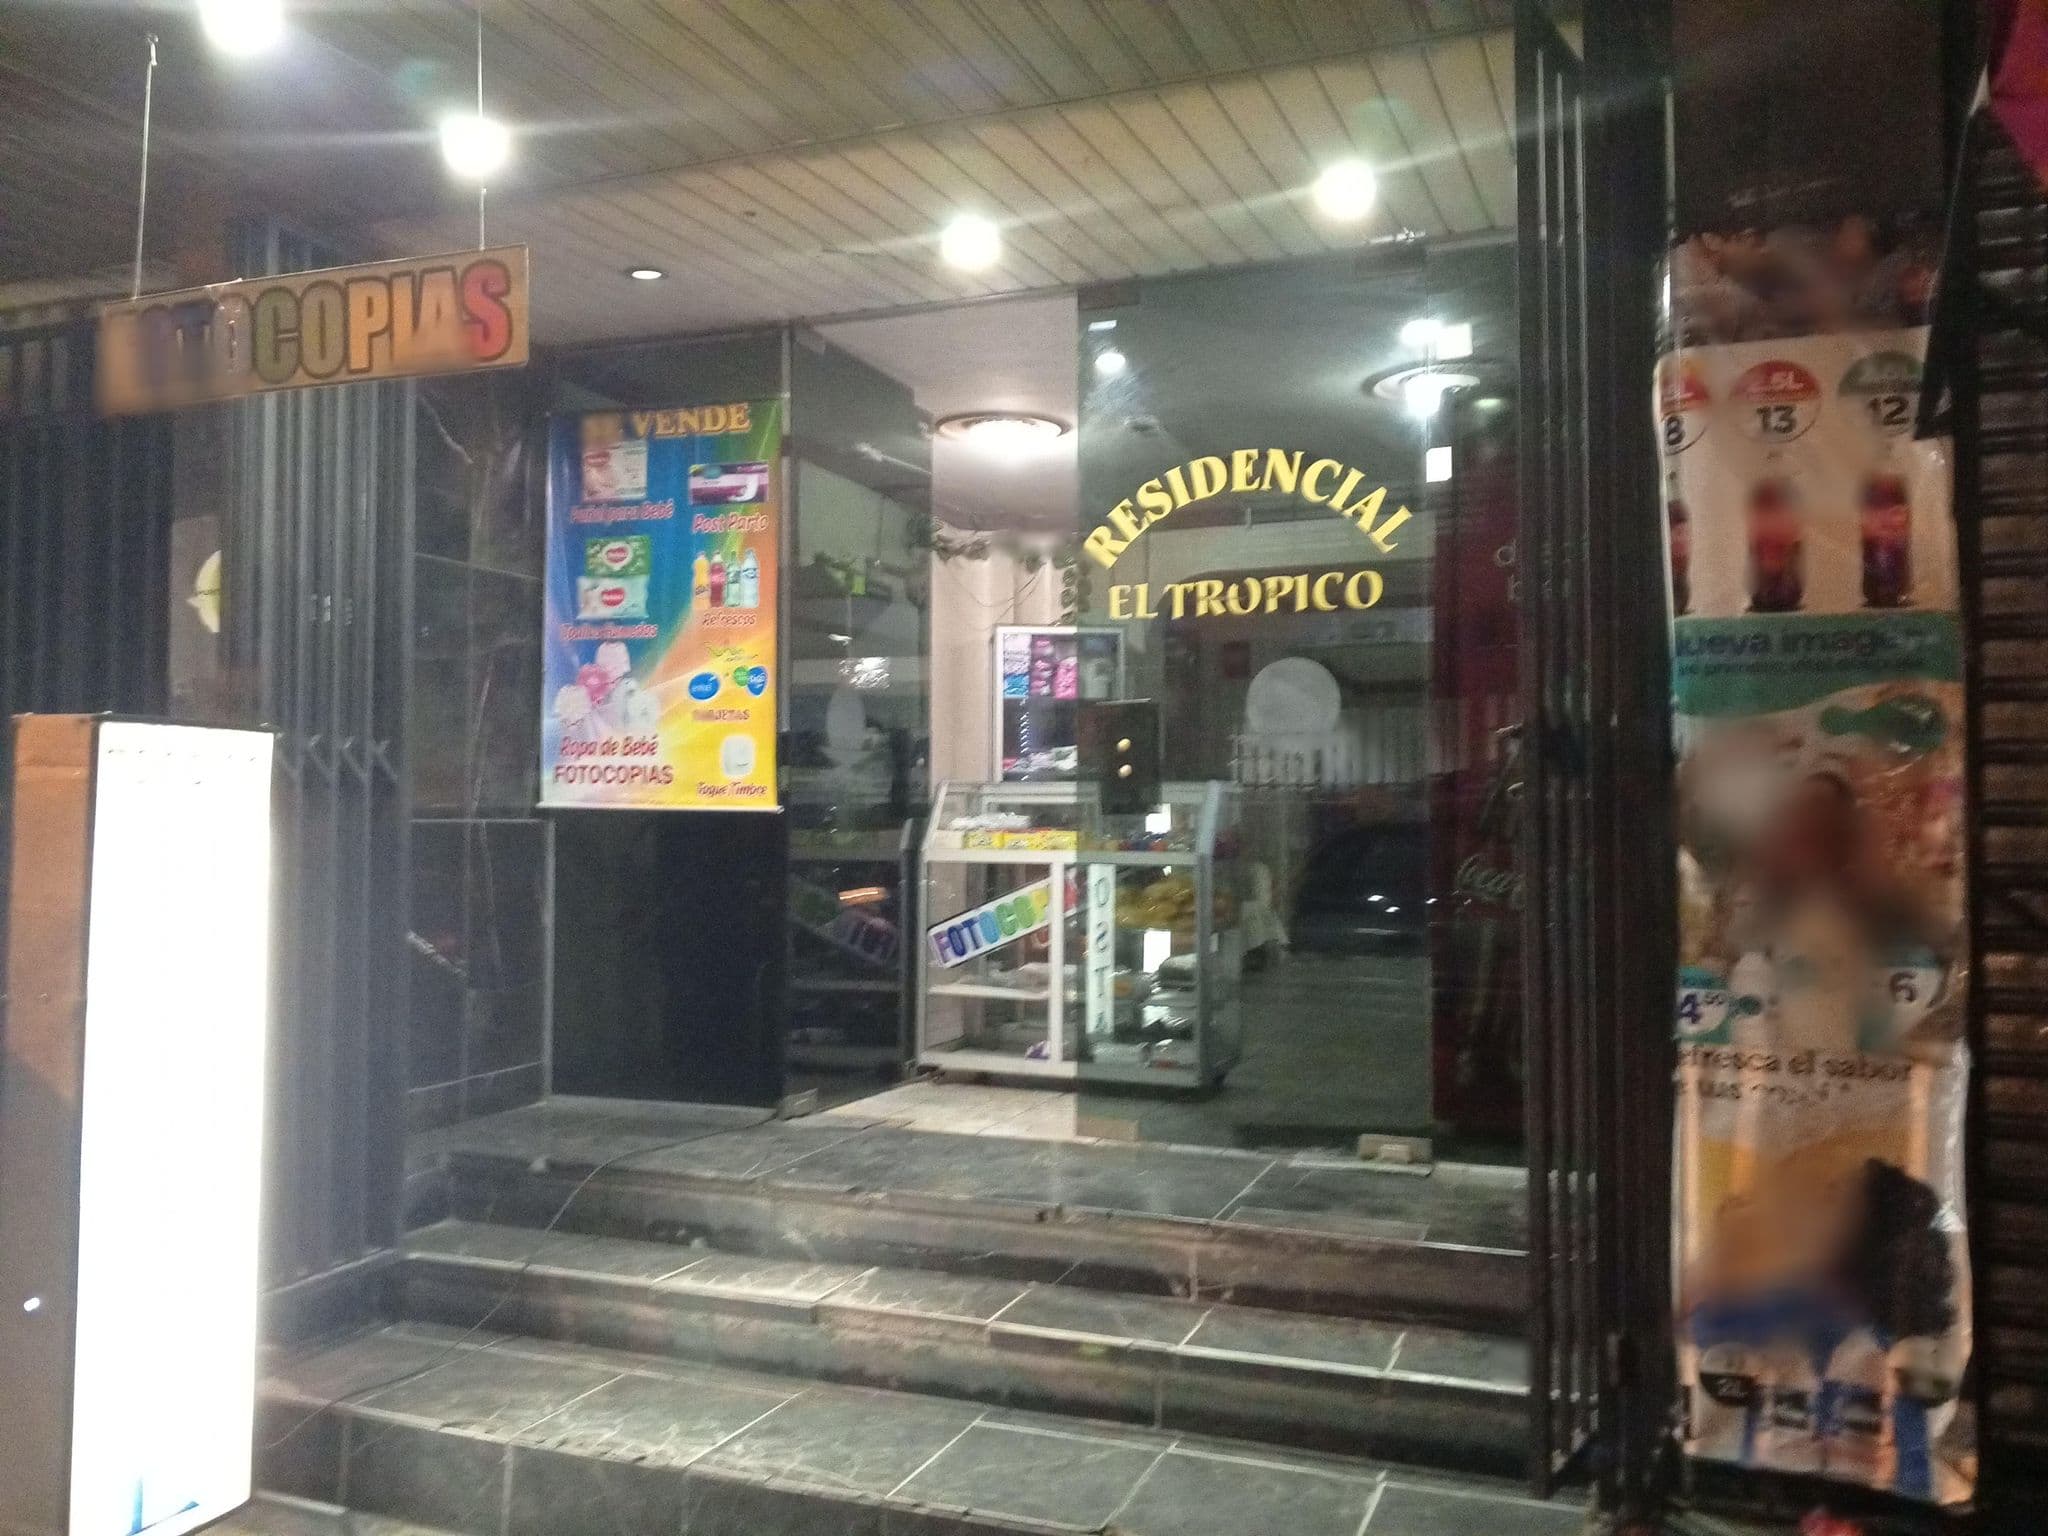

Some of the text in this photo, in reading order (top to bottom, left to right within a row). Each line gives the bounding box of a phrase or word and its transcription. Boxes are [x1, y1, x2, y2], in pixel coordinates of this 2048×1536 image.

[104, 259, 513, 390] TOCOPIAS
[631, 404, 751, 438] VENDE
[1756, 406, 1798, 434] 13
[1867, 396, 1908, 426] 12
[1083, 448, 1413, 570] RESIDENCIAL
[1108, 570, 1384, 620] EL TROPICO
[561, 734, 659, 760] Ropa de Bebé
[553, 764, 674, 784] FOTOCOPIAS
